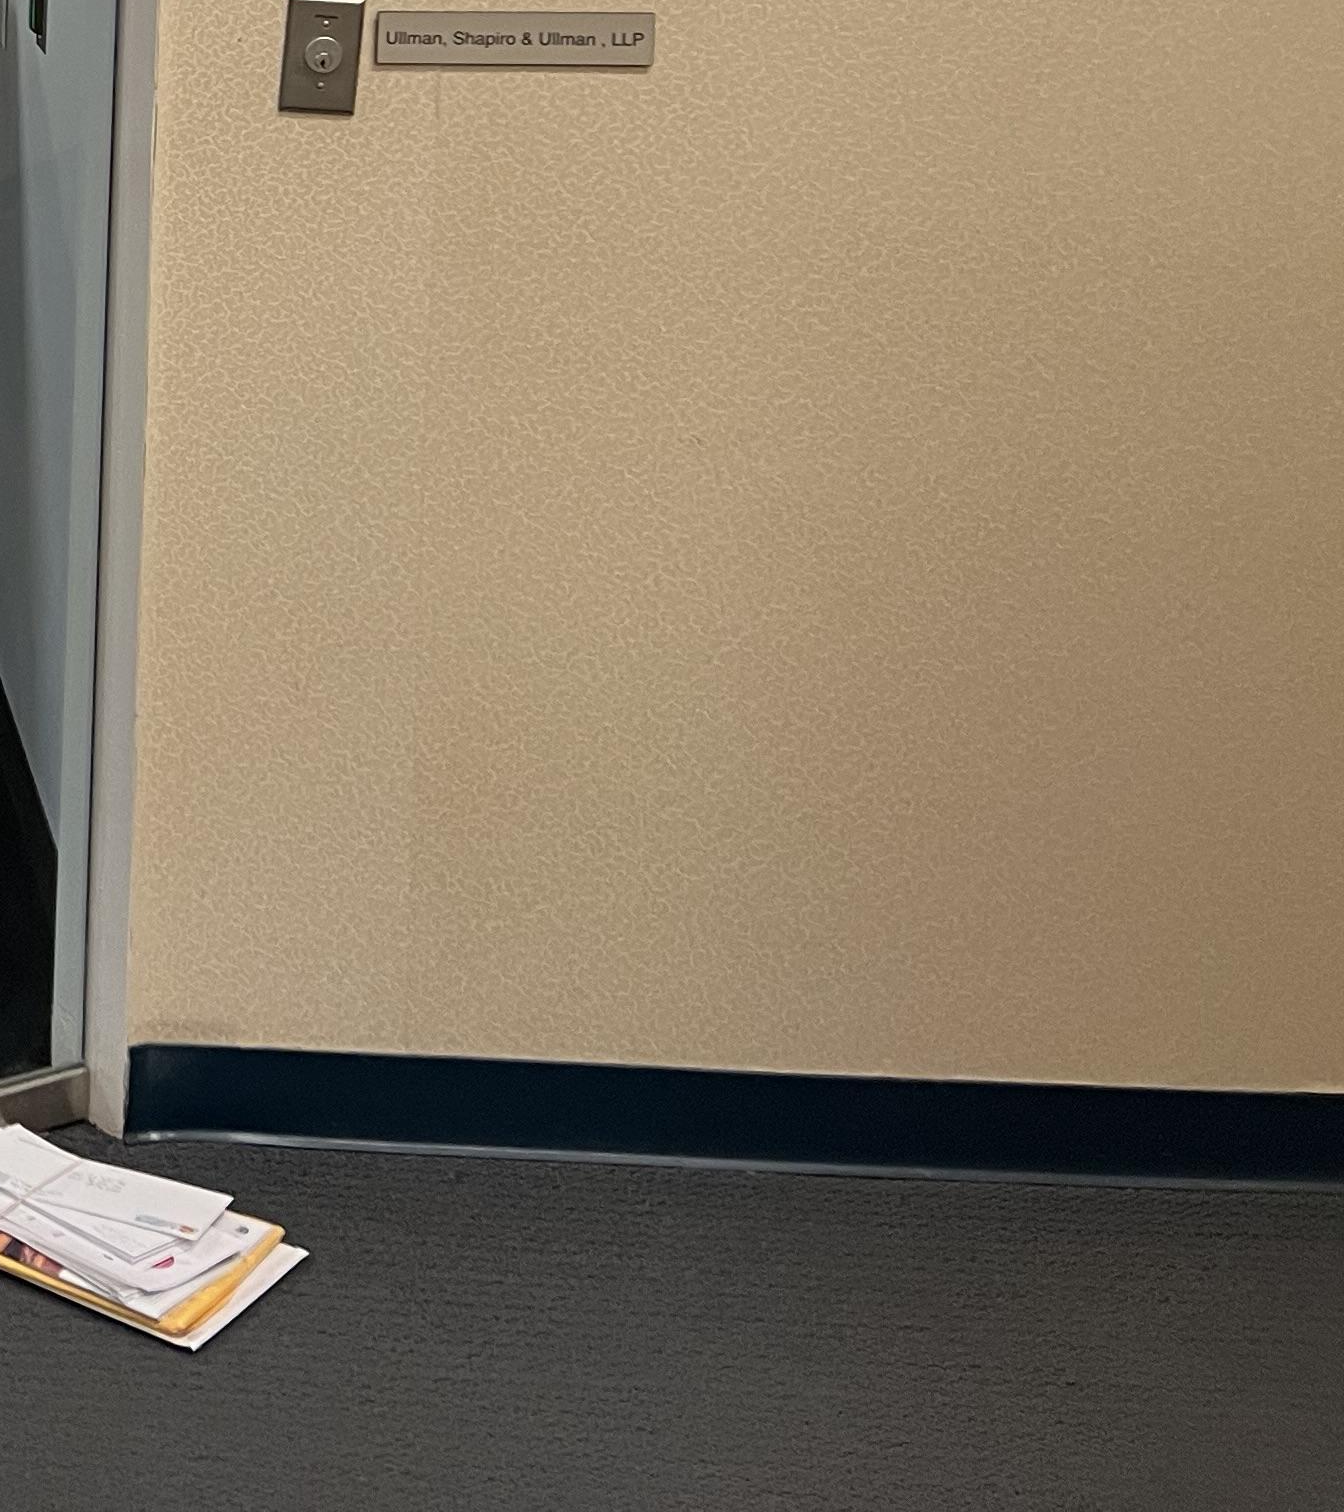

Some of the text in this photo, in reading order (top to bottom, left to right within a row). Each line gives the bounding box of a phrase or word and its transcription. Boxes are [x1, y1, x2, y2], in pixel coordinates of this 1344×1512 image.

[386, 31, 448, 47] Ullman,
[453, 31, 516, 48] Shapiro
[521, 32, 533, 46] &
[539, 32, 596, 46] Ullman
[612, 32, 645, 47] LLP
